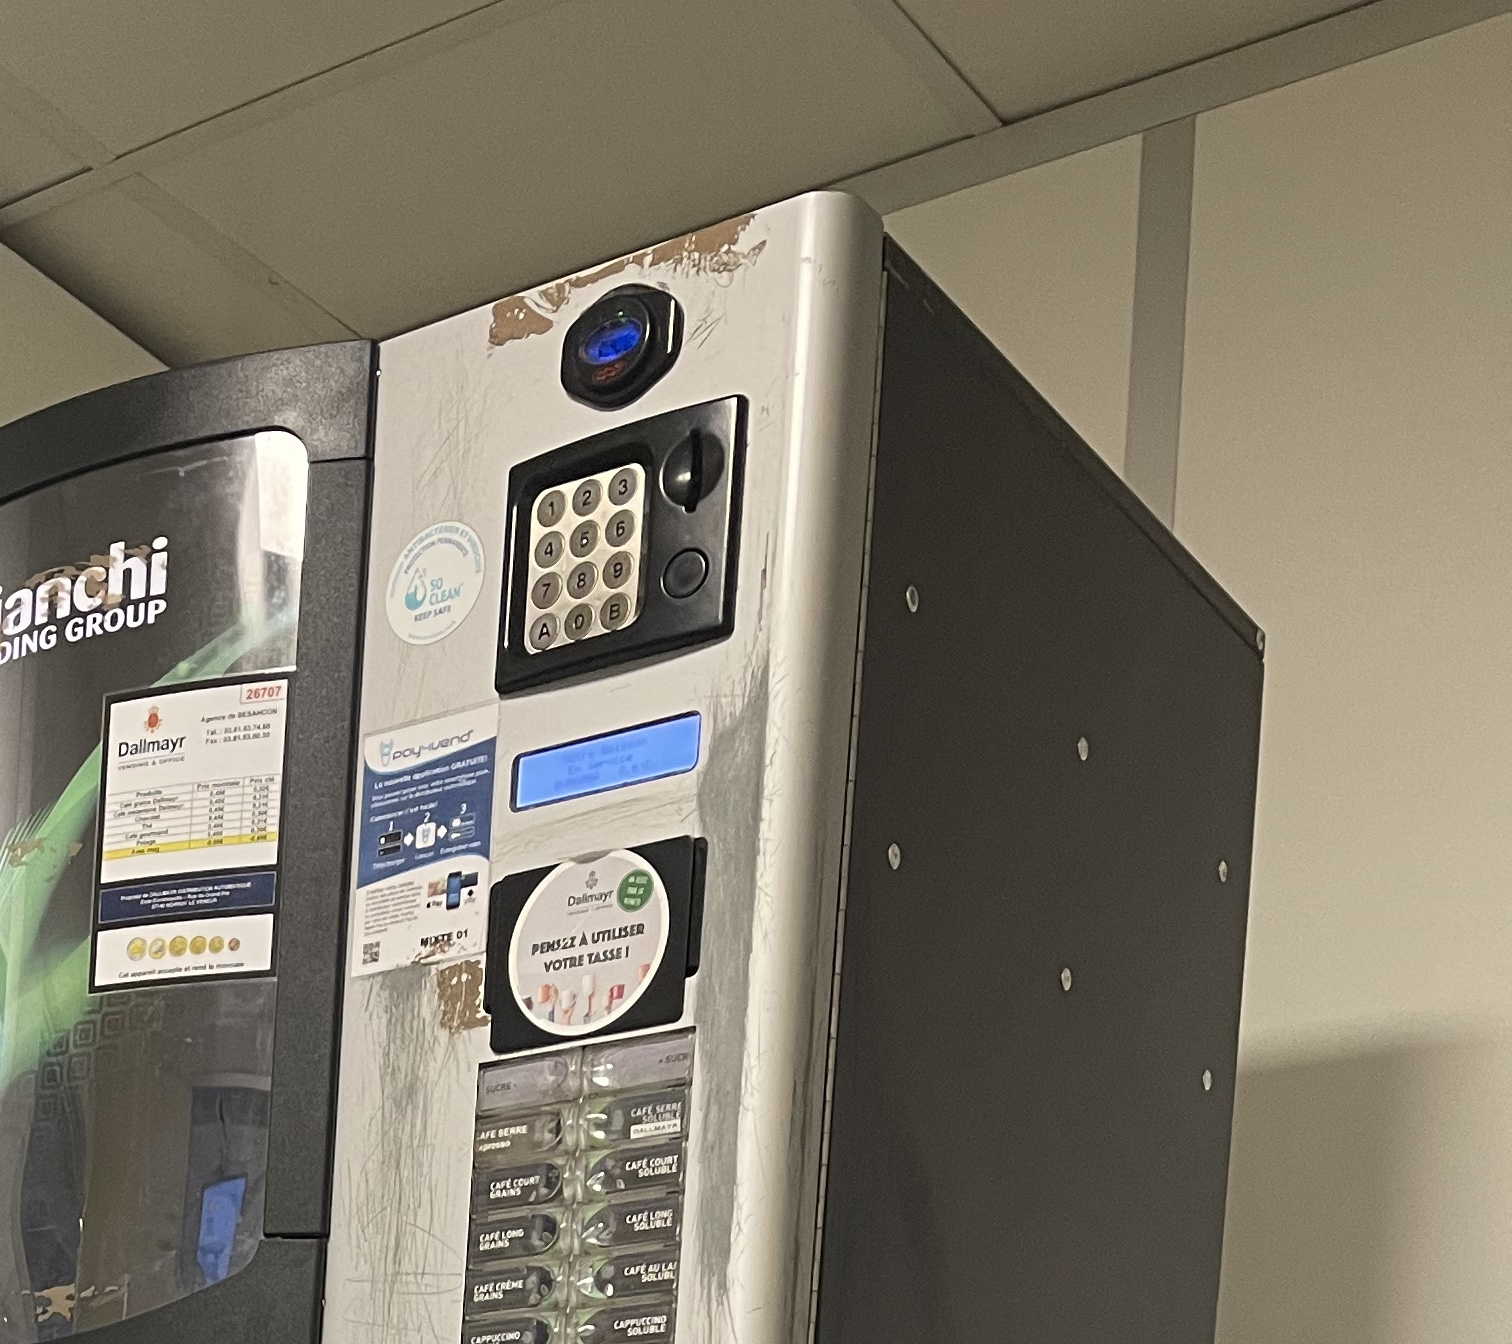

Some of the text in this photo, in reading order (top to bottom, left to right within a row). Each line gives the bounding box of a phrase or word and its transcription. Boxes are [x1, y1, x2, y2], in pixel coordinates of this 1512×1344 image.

[548, 479, 628, 515] 1 2 3
[544, 521, 625, 558] 4 5 6
[431, 577, 443, 592] SO
[542, 562, 623, 598] 7 8 9
[429, 587, 461, 606] CLEAN
[64, 598, 167, 642] GROUP
[414, 605, 451, 622] KEEP SAFE
[538, 603, 620, 639] A 0 B
[246, 686, 282, 700] 26707
[118, 735, 186, 757] Dallmayr
[567, 889, 614, 907] Dallmayr
[456, 928, 468, 939] 01
[591, 923, 645, 944] UTILISER
[544, 954, 584, 973] VOTRE
[587, 947, 622, 965] TASSE
[664, 1053, 688, 1064] SUCR
[626, 1155, 679, 1171] CAFÉ COURT
[638, 1164, 678, 1177] SOLUBLE
[490, 1175, 540, 1191] CAFÉ COURT
[489, 1188, 521, 1199] GRAINS
[626, 1209, 673, 1224] CAFÉ LONG
[633, 1218, 673, 1231] SOLUBLE
[502, 1228, 524, 1240] LONG
[479, 1240, 510, 1250] GRAINS
[624, 1264, 660, 1276] CAFÉ AU
[641, 1271, 675, 1283] SOLUBL
[474, 1291, 504, 1302] GRAINS
[614, 1315, 667, 1330] CAPPUCCINO
[627, 1324, 666, 1336] SOLUBLE
[470, 1331, 521, 1344] CAPPUCCINO
